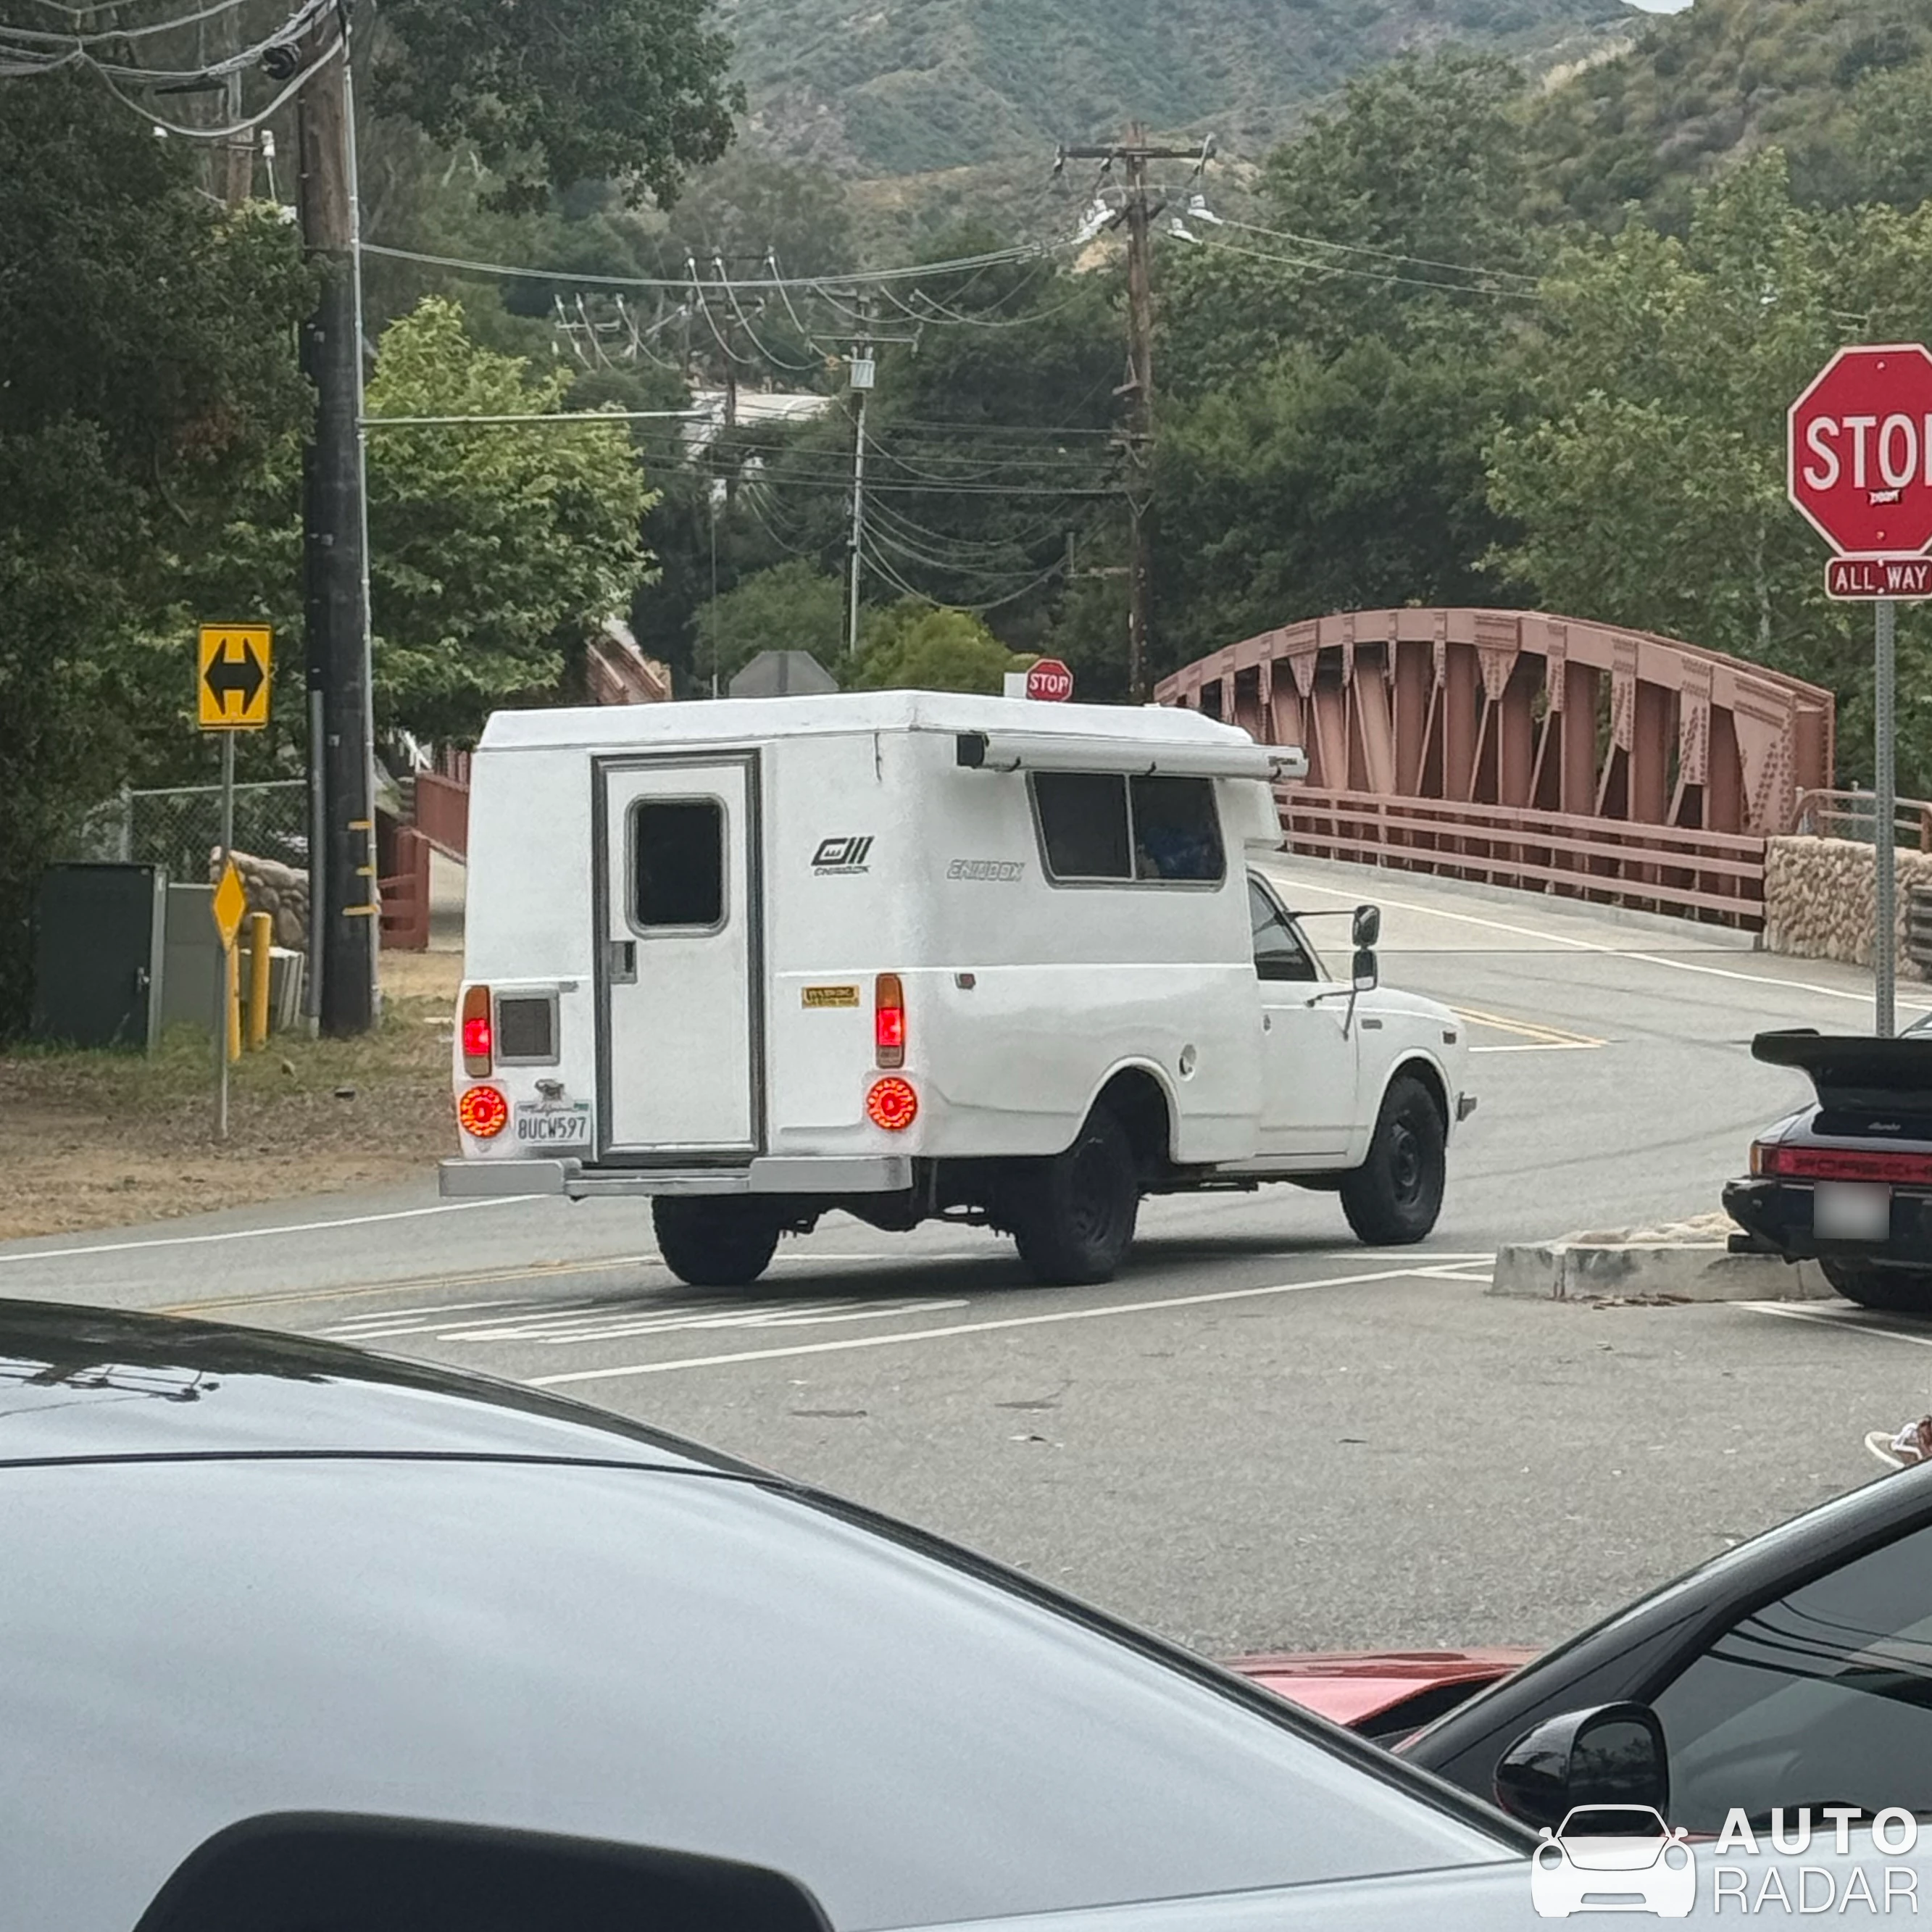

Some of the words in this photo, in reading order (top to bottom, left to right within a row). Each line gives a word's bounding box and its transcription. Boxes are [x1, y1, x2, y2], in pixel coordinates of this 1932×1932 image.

[1803, 414, 1932, 491] STO
[1835, 567, 1875, 591] ALL
[1887, 565, 1928, 590] WAY
[1029, 673, 1069, 693] STOP
[517, 1117, 586, 1139] 8UCW597
